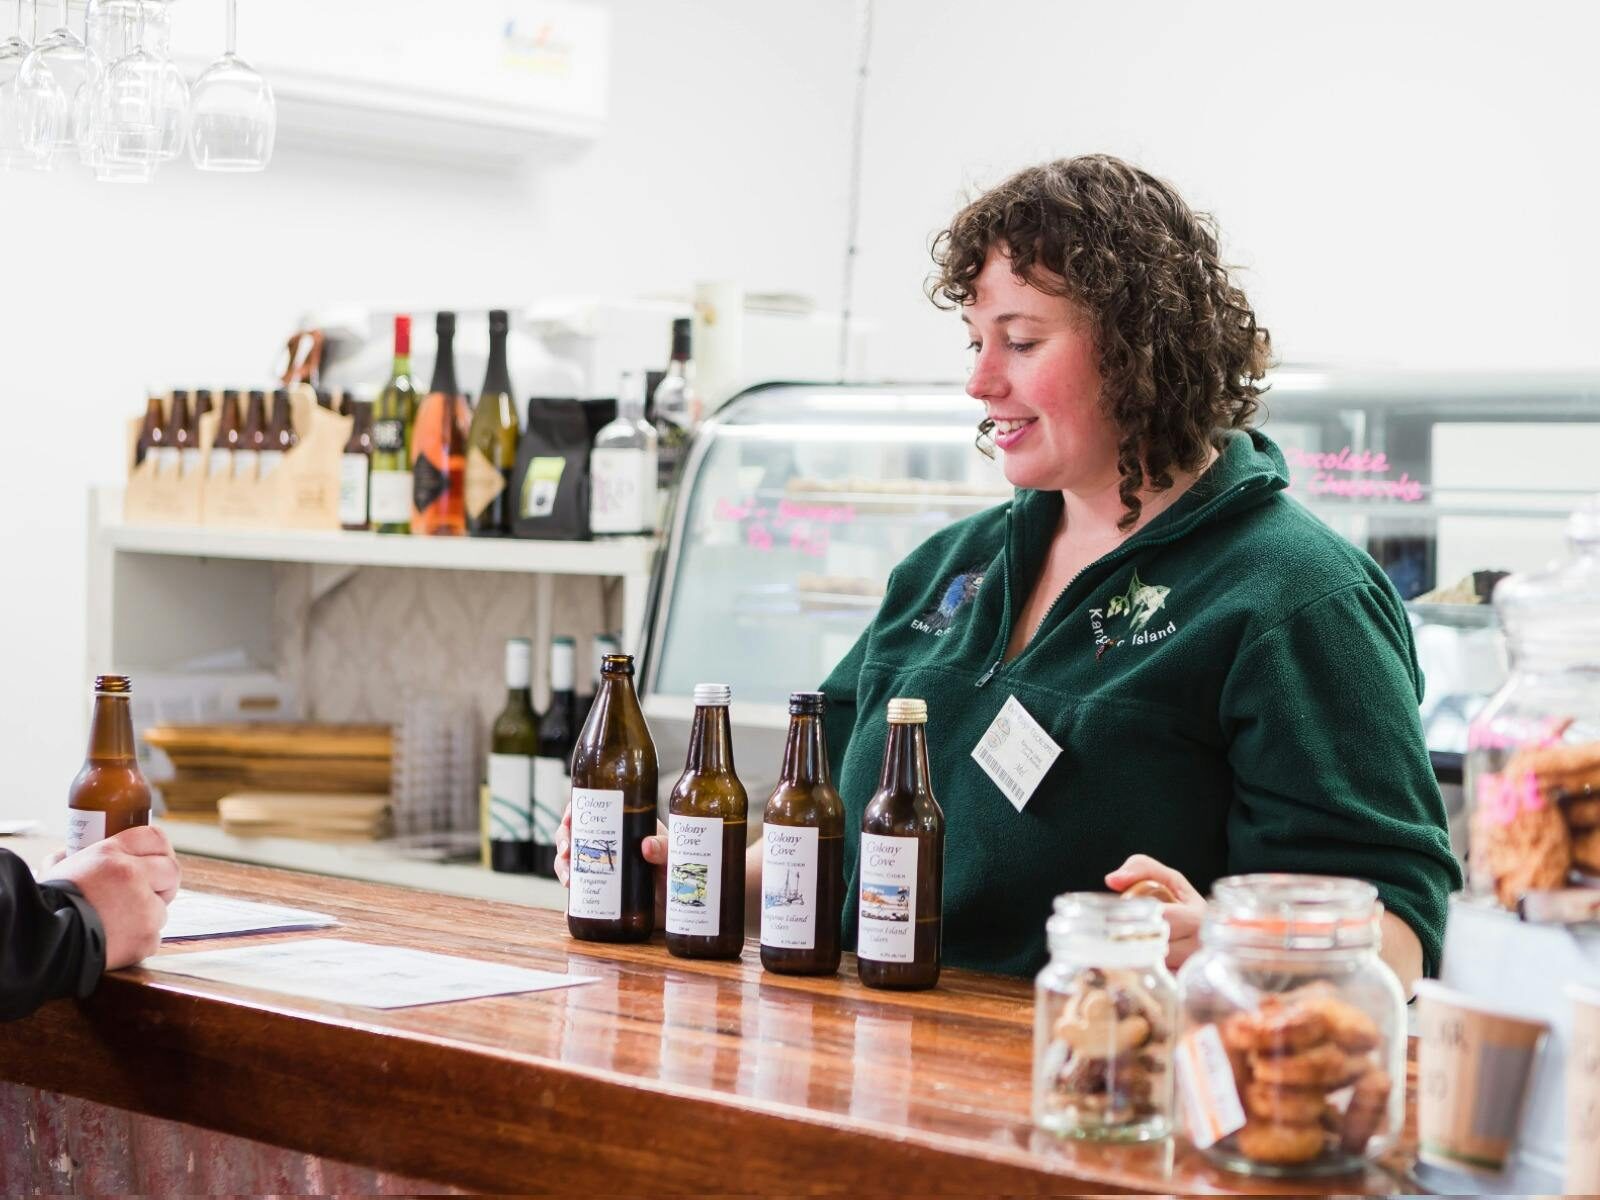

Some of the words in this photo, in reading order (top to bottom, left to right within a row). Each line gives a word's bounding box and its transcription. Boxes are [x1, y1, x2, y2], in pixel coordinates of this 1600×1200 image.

[1132, 620, 1177, 646] Island
[576, 795, 612, 812] Colony
[580, 810, 607, 825] Cove
[673, 822, 707, 837] Colony
[676, 834, 702, 847] Cove
[767, 831, 803, 847] Colony
[770, 844, 796, 856] Cove
[867, 842, 903, 857] Colony
[869, 854, 896, 867] Cove
[785, 913, 809, 923] Island
[884, 926, 909, 937] Island
